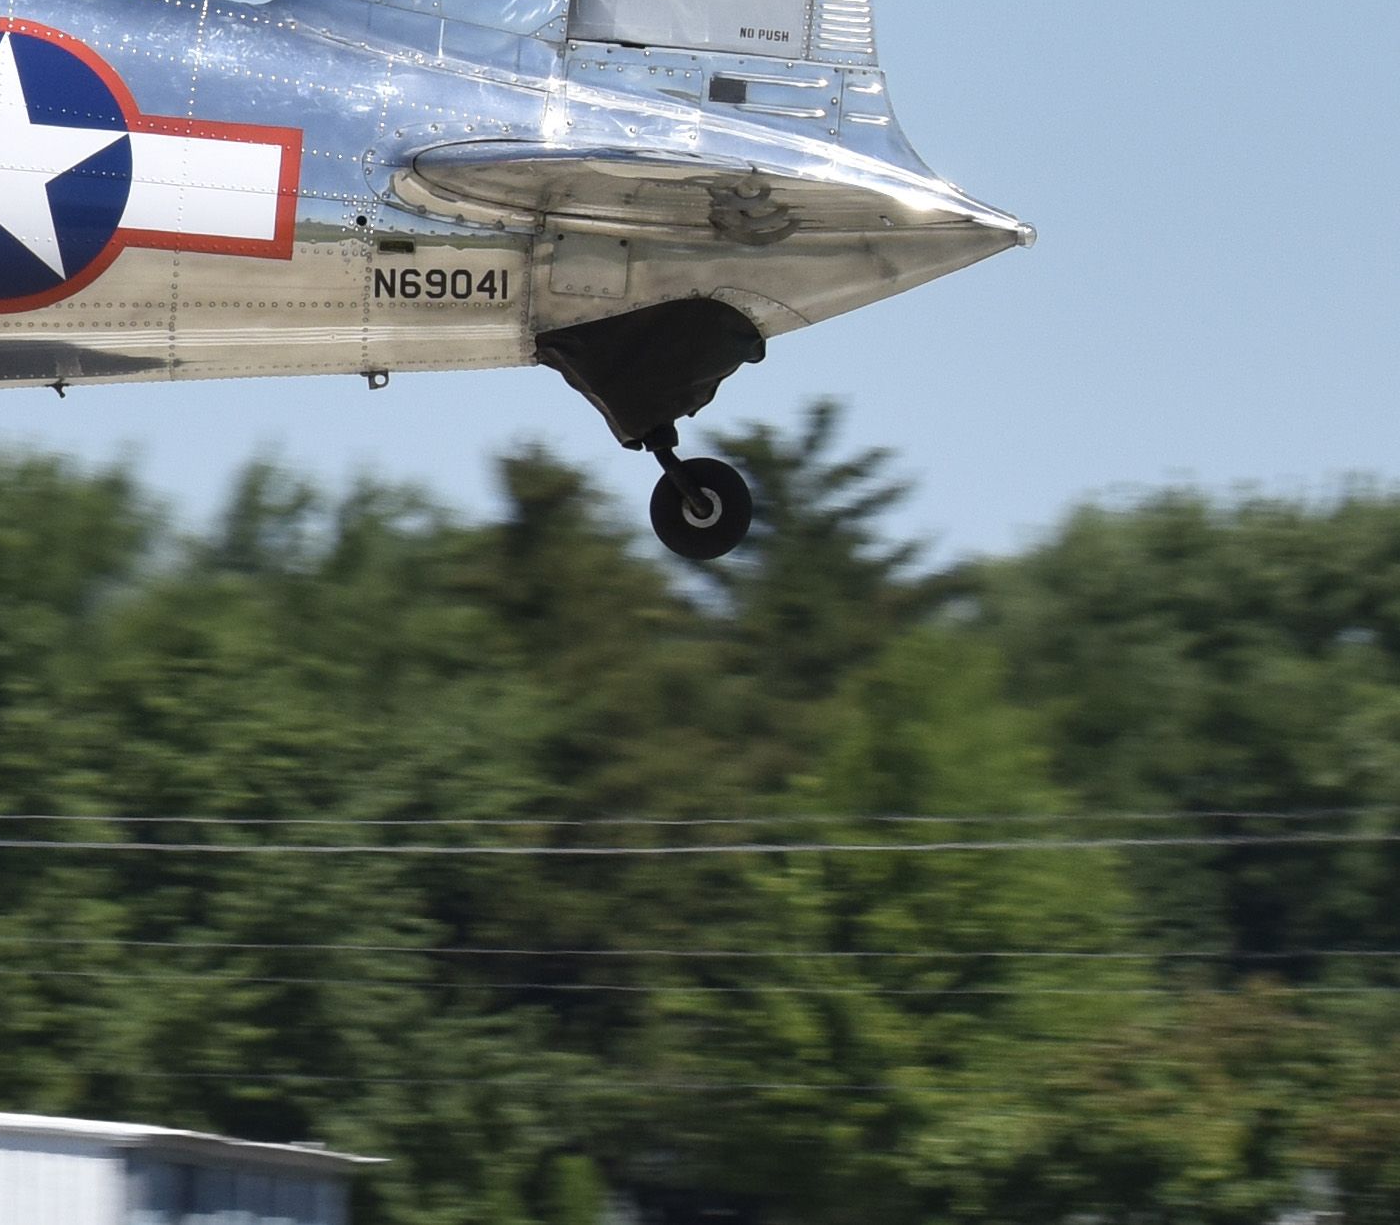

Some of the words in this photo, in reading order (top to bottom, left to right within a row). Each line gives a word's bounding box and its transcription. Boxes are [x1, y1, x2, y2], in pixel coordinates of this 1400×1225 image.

[739, 27, 755, 39] NO
[758, 29, 790, 43] PUSH
[374, 268, 508, 300] N69041
